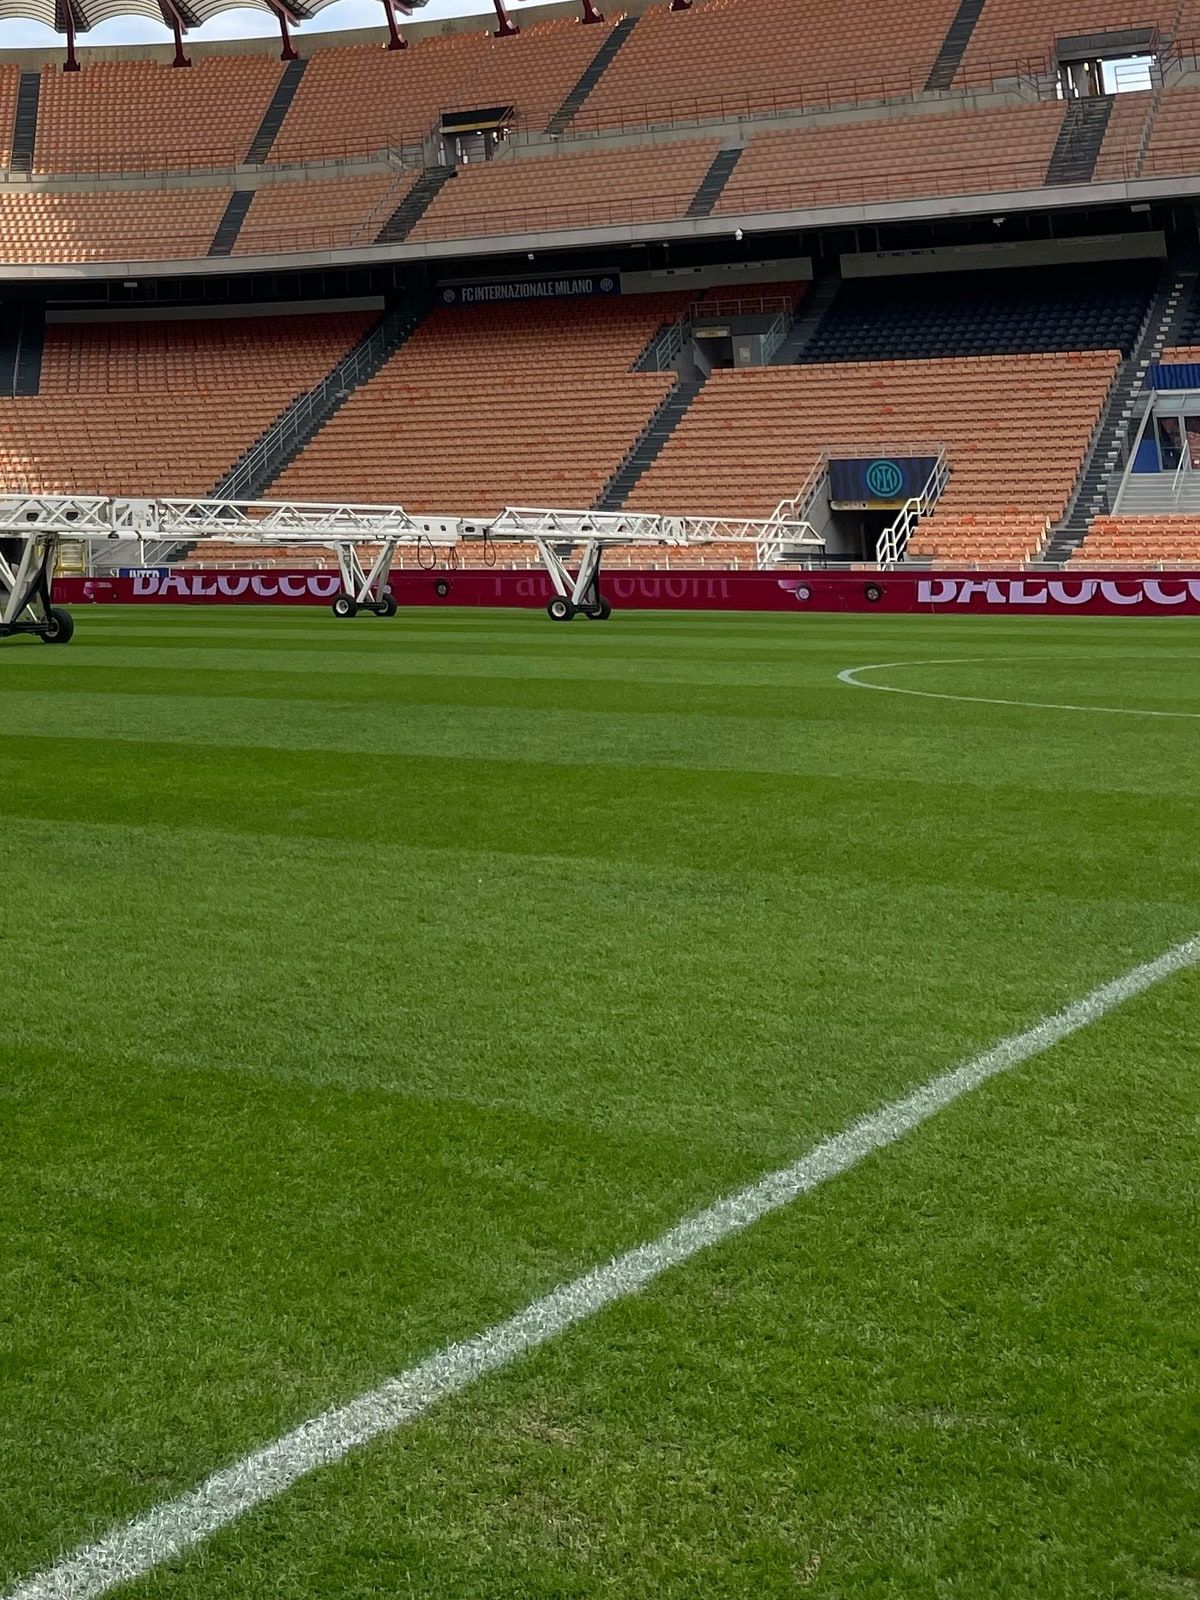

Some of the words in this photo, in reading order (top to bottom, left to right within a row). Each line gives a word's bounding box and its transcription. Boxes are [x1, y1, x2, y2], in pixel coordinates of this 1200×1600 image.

[462, 288, 473, 301] FC
[475, 282, 553, 300] INTERNAZIONALE
[555, 279, 593, 294] MILANO
